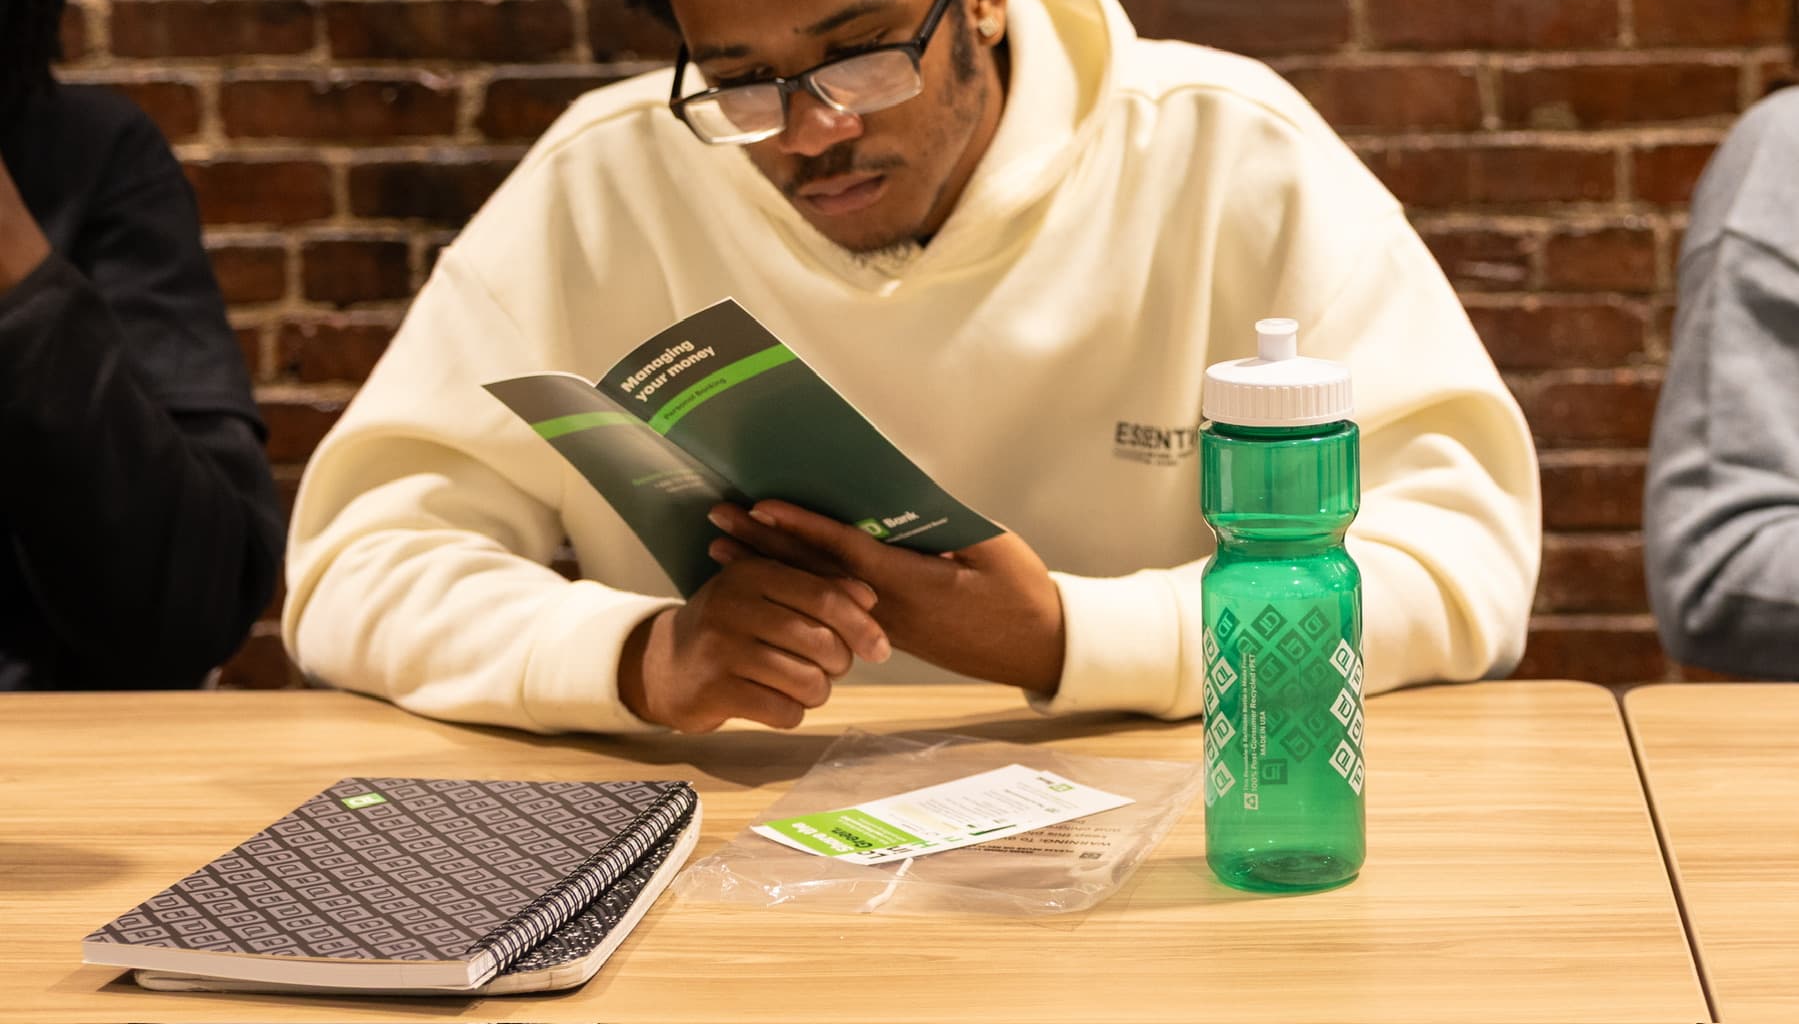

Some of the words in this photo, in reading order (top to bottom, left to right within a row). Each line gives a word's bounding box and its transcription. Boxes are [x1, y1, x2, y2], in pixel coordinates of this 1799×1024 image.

[621, 340, 695, 392] Managing
[635, 372, 668, 403] your
[666, 346, 716, 377] money
[882, 511, 920, 528] Bank
[1249, 673, 1257, 709] Recycled
[1249, 710, 1258, 770] Post-Consumer
